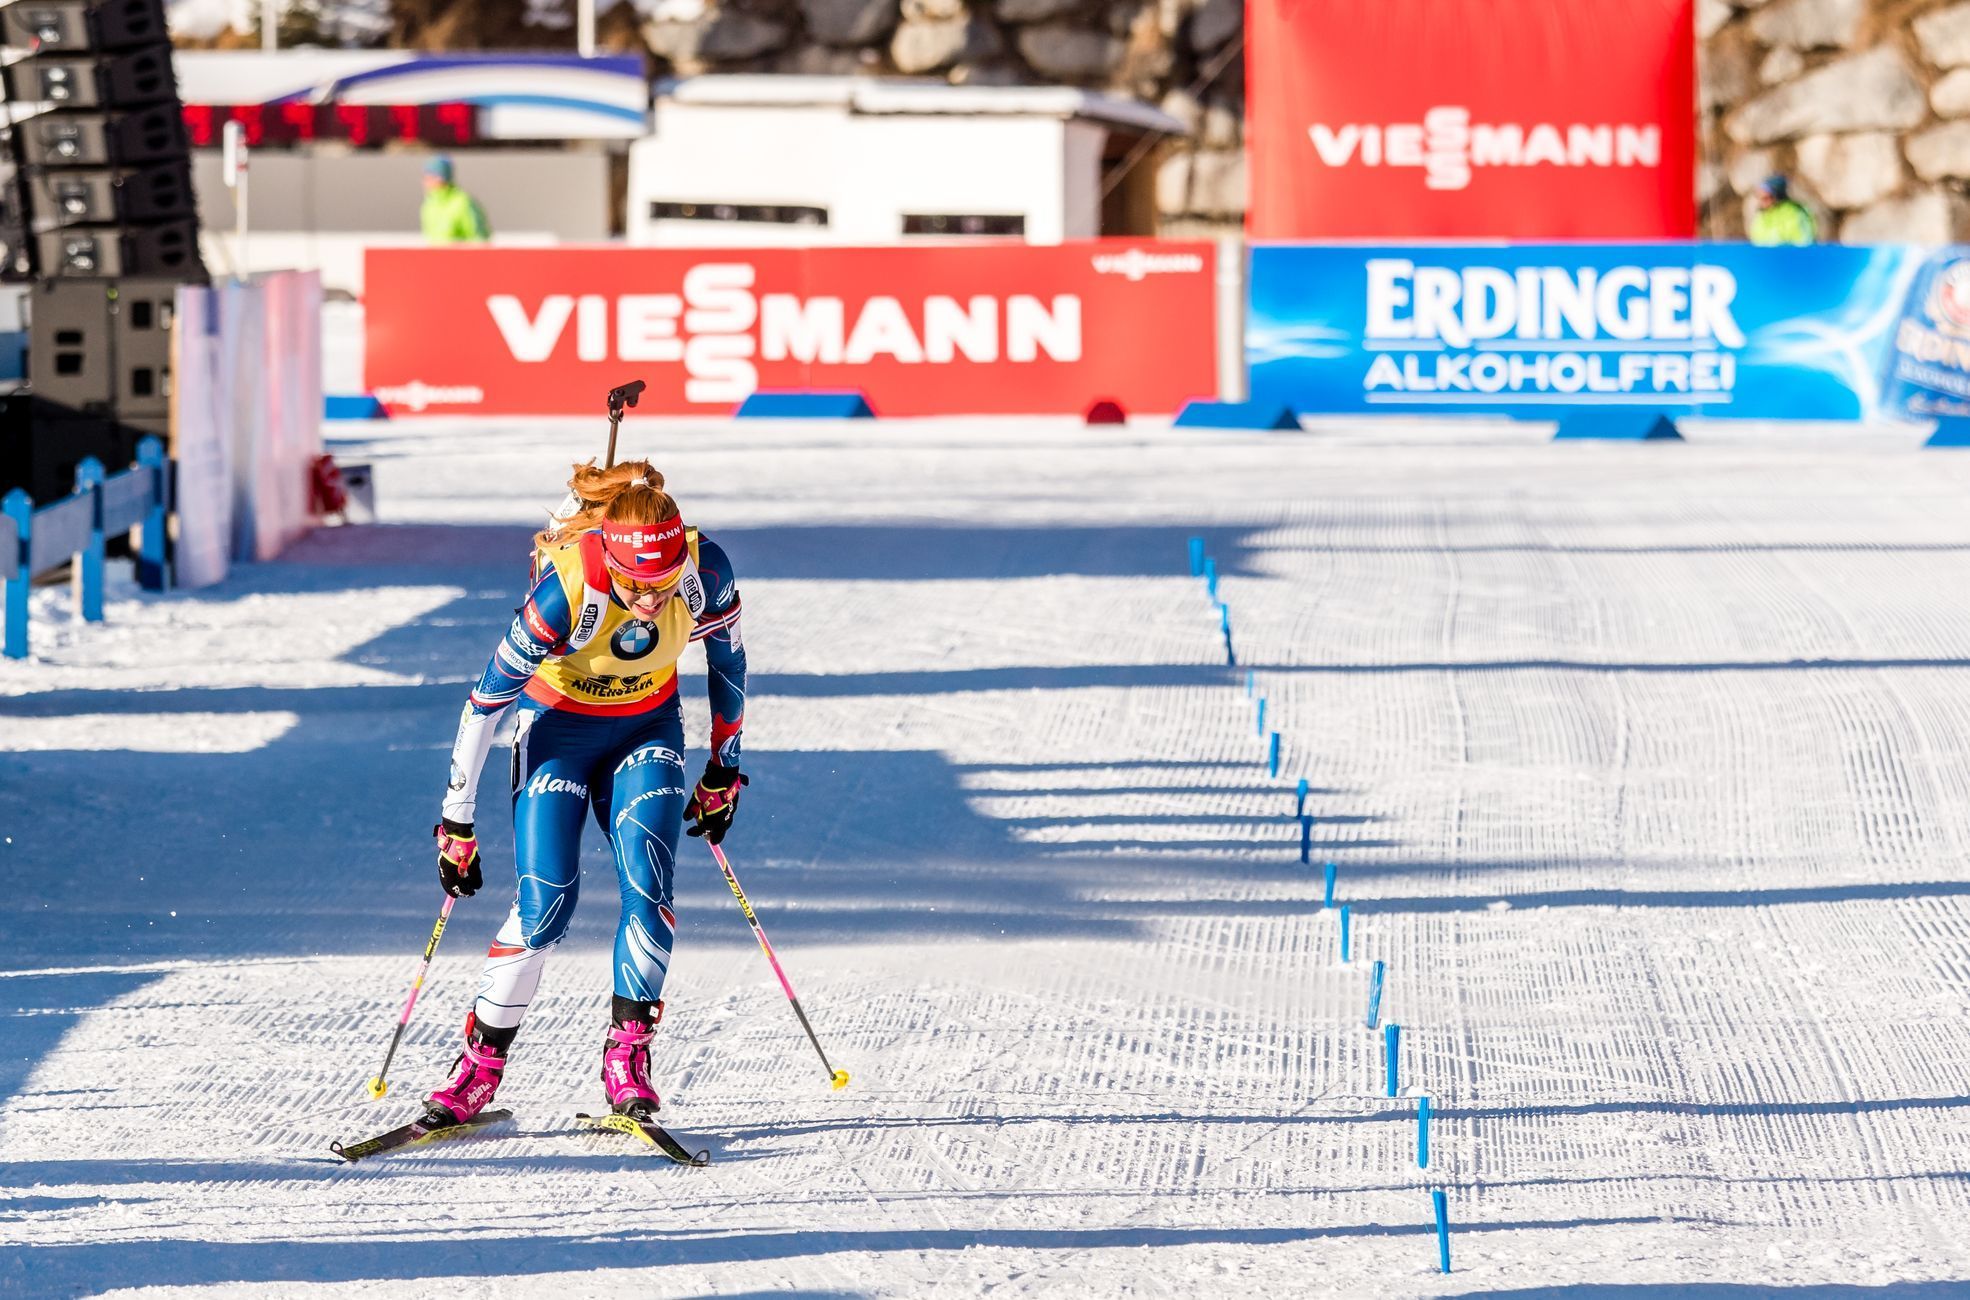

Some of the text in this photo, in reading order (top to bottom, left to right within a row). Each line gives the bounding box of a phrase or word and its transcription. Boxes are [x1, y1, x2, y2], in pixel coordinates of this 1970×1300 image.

[1364, 258, 1746, 349] ERDINGER
[1363, 352, 1736, 391] ALKOHOLFREI
[617, 620, 656, 635] BMW
